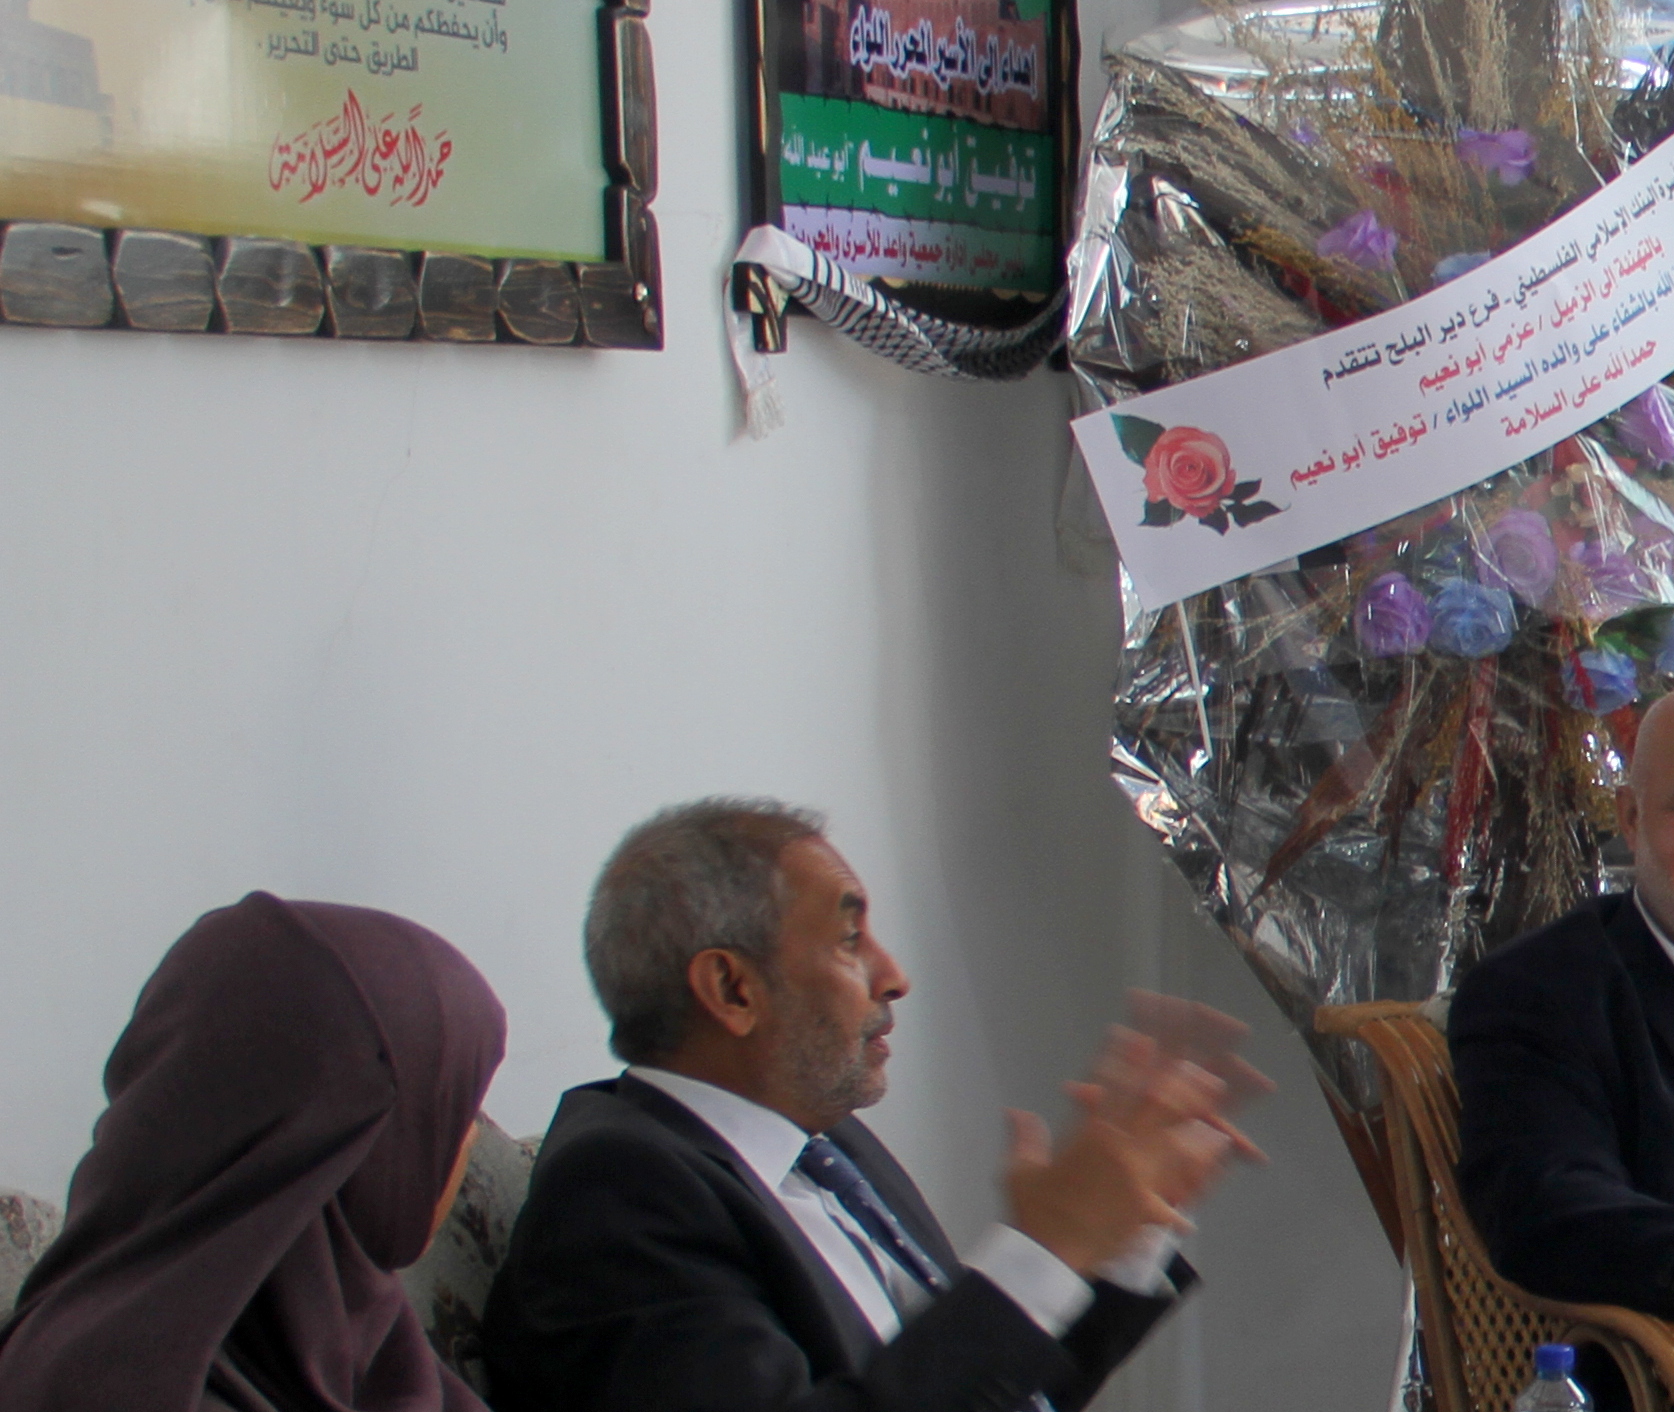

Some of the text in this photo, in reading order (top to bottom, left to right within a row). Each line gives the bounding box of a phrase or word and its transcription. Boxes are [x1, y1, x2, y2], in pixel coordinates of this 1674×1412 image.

[386, 12, 411, 34] من
[415, 9, 479, 48] يحفظكم
[482, 9, 508, 53] وأن
[850, 5, 893, 73] اللواء
[324, 36, 362, 67] حتى
[367, 41, 419, 76] الطريق
[857, 128, 932, 196] نعيم
[965, 135, 1036, 211] توفيق
[1631, 184, 1659, 219] البنك
[909, 230, 943, 271] جمعية
[1585, 205, 1632, 264] الإسلامي
[1617, 234, 1665, 280] بالتهنئة
[1550, 279, 1597, 329] الزميل
[1656, 269, 1674, 298] الله
[1437, 311, 1466, 345] دير
[1469, 292, 1500, 328] فرع
[1613, 289, 1659, 336] بالشفاء
[1387, 323, 1433, 366] البلح
[1492, 320, 1535, 365] عزمي
[1541, 338, 1581, 375] والده
[1583, 323, 1611, 357] على
[1322, 342, 1383, 390] تتقدم
[1418, 357, 1461, 396] نعيم
[1494, 360, 1539, 401] السيد
[1445, 382, 1491, 424] اللواء
[1500, 387, 1569, 438] السلامة
[1572, 375, 1602, 410] على
[1371, 412, 1428, 461] توفيق
[1289, 448, 1337, 488] نعيم
